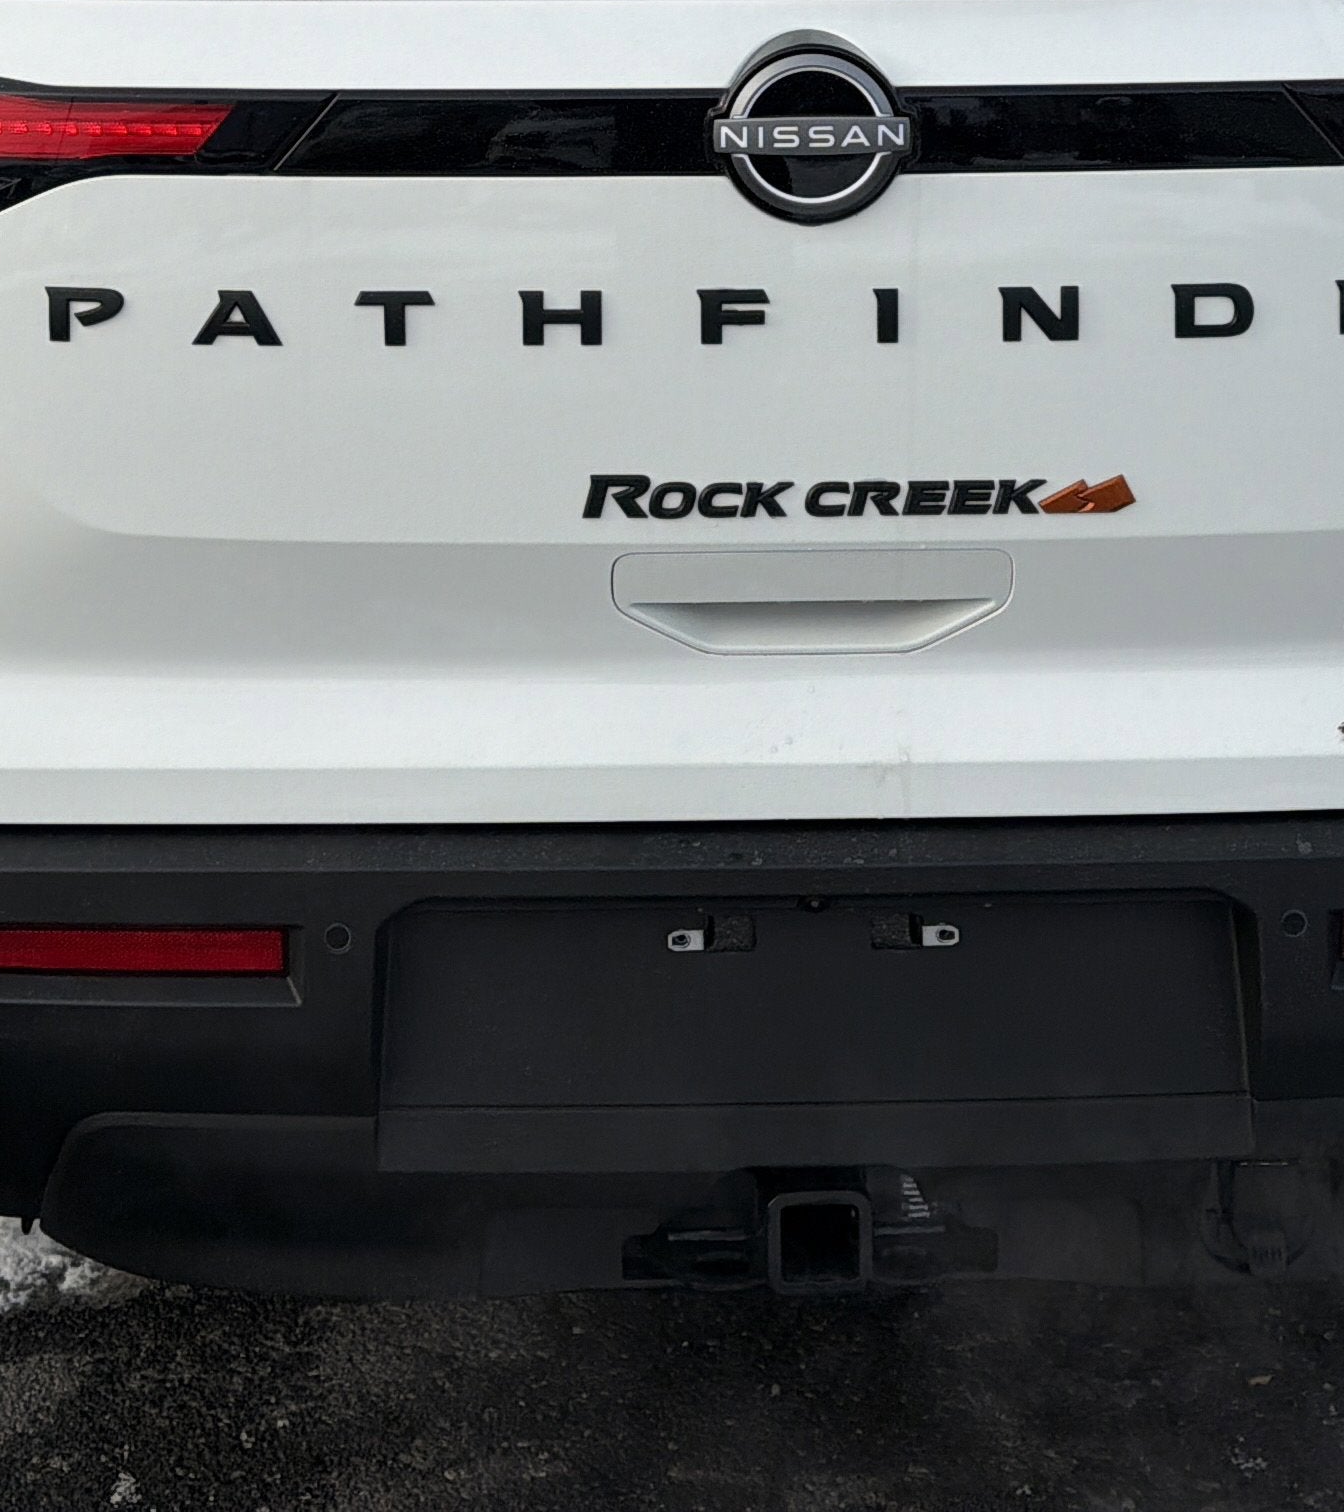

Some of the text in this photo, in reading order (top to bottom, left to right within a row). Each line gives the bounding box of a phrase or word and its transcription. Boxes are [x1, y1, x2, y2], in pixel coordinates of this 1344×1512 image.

[720, 123, 905, 149] NISSAN
[582, 474, 1047, 520] ROCK CREEK
